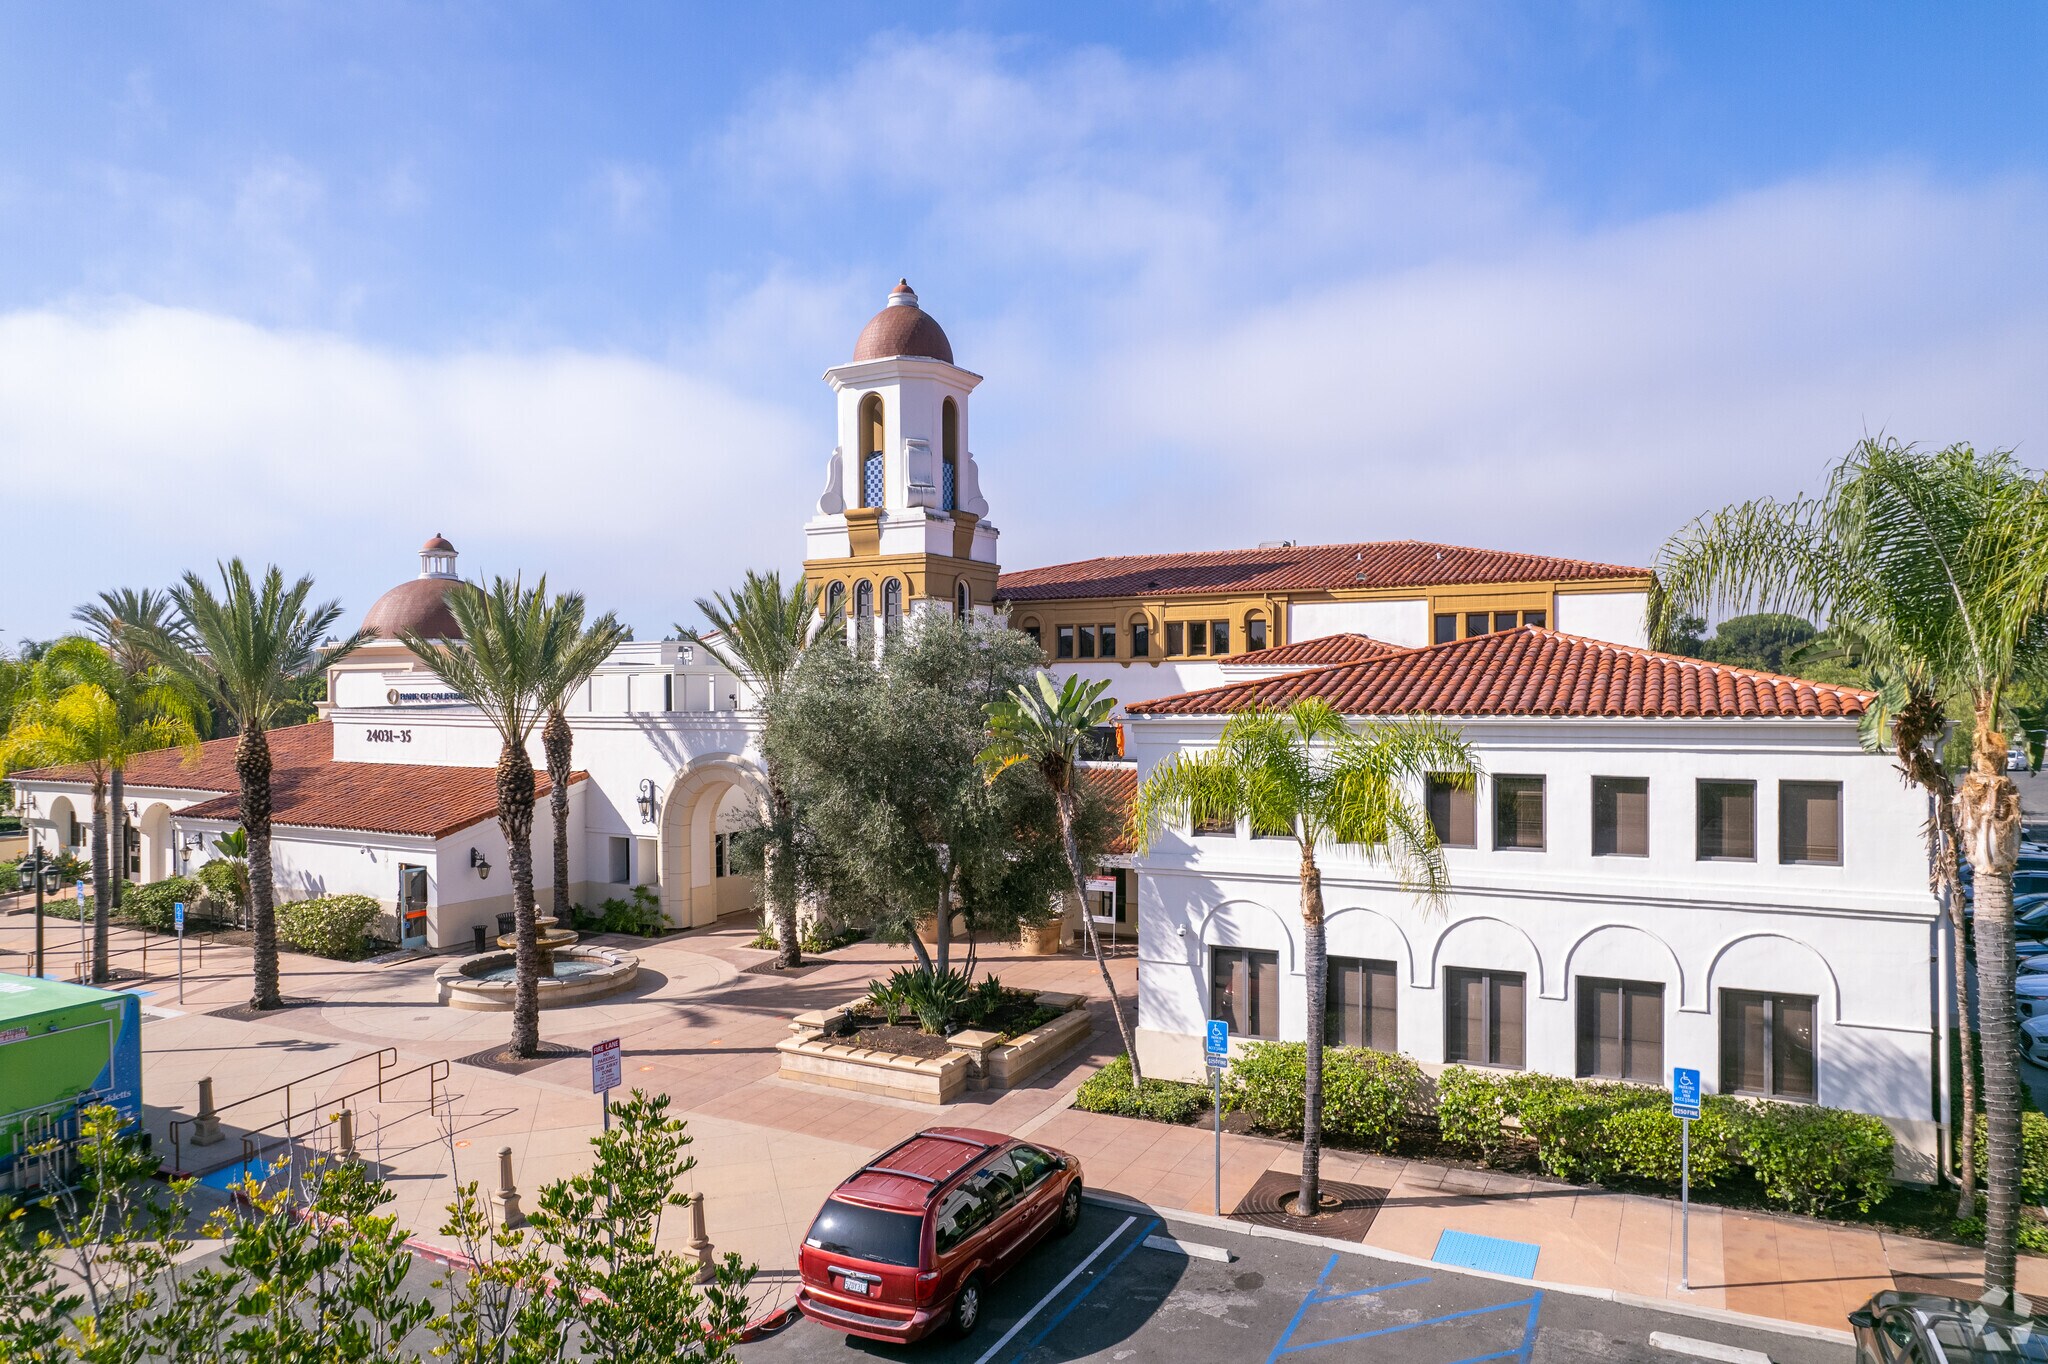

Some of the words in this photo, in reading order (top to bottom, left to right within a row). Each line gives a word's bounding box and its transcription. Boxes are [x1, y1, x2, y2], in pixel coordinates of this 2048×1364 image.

[366, 729, 412, 743] 24031-35
[594, 1045, 604, 1054] FIRE
[605, 1040, 619, 1050] LANE
[597, 1055, 616, 1064] PARKING
[606, 1061, 618, 1069] AWAY
[602, 1068, 613, 1076] ZONE
[1674, 1096, 1699, 1104] ACCESSIBLE
